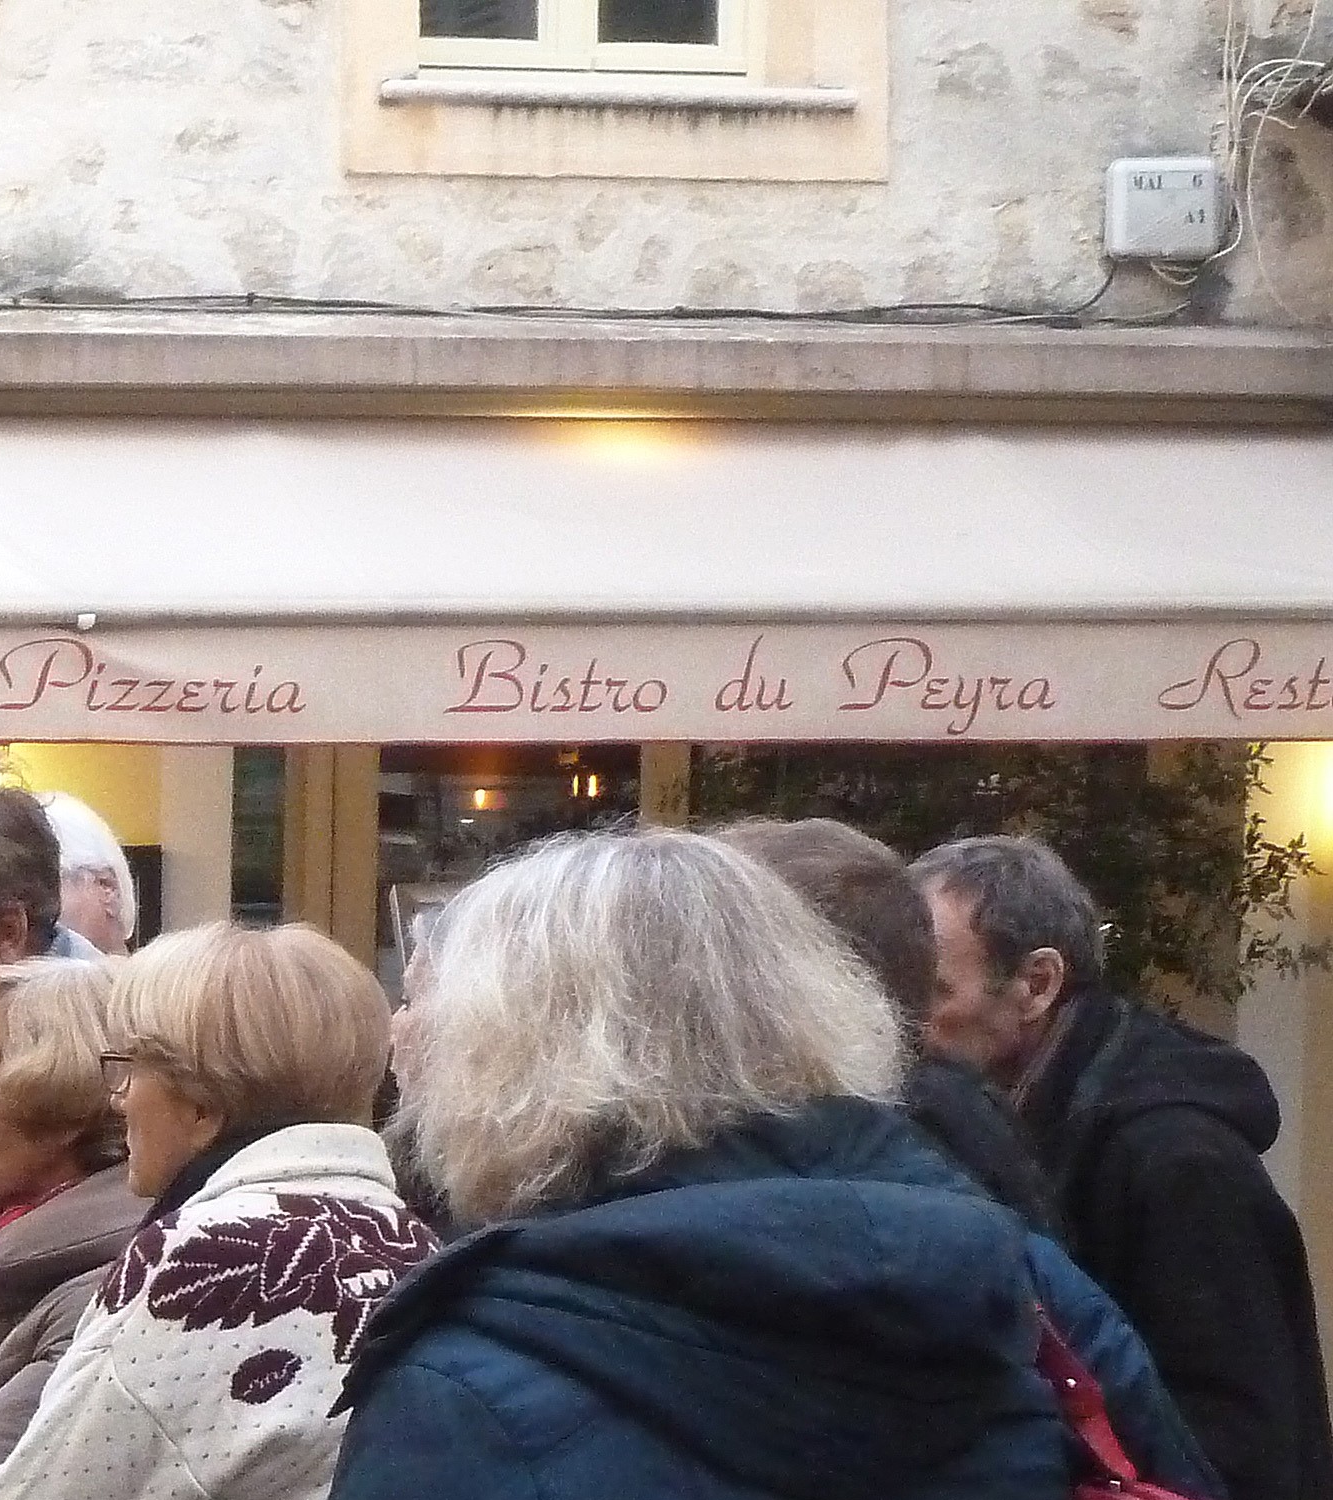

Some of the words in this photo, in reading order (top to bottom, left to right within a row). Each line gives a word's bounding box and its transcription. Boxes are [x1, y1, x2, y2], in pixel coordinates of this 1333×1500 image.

[442, 638, 670, 715] Bistro
[715, 633, 794, 713] du
[837, 636, 1057, 735] Peyra
[1158, 637, 1333, 720] Rest
